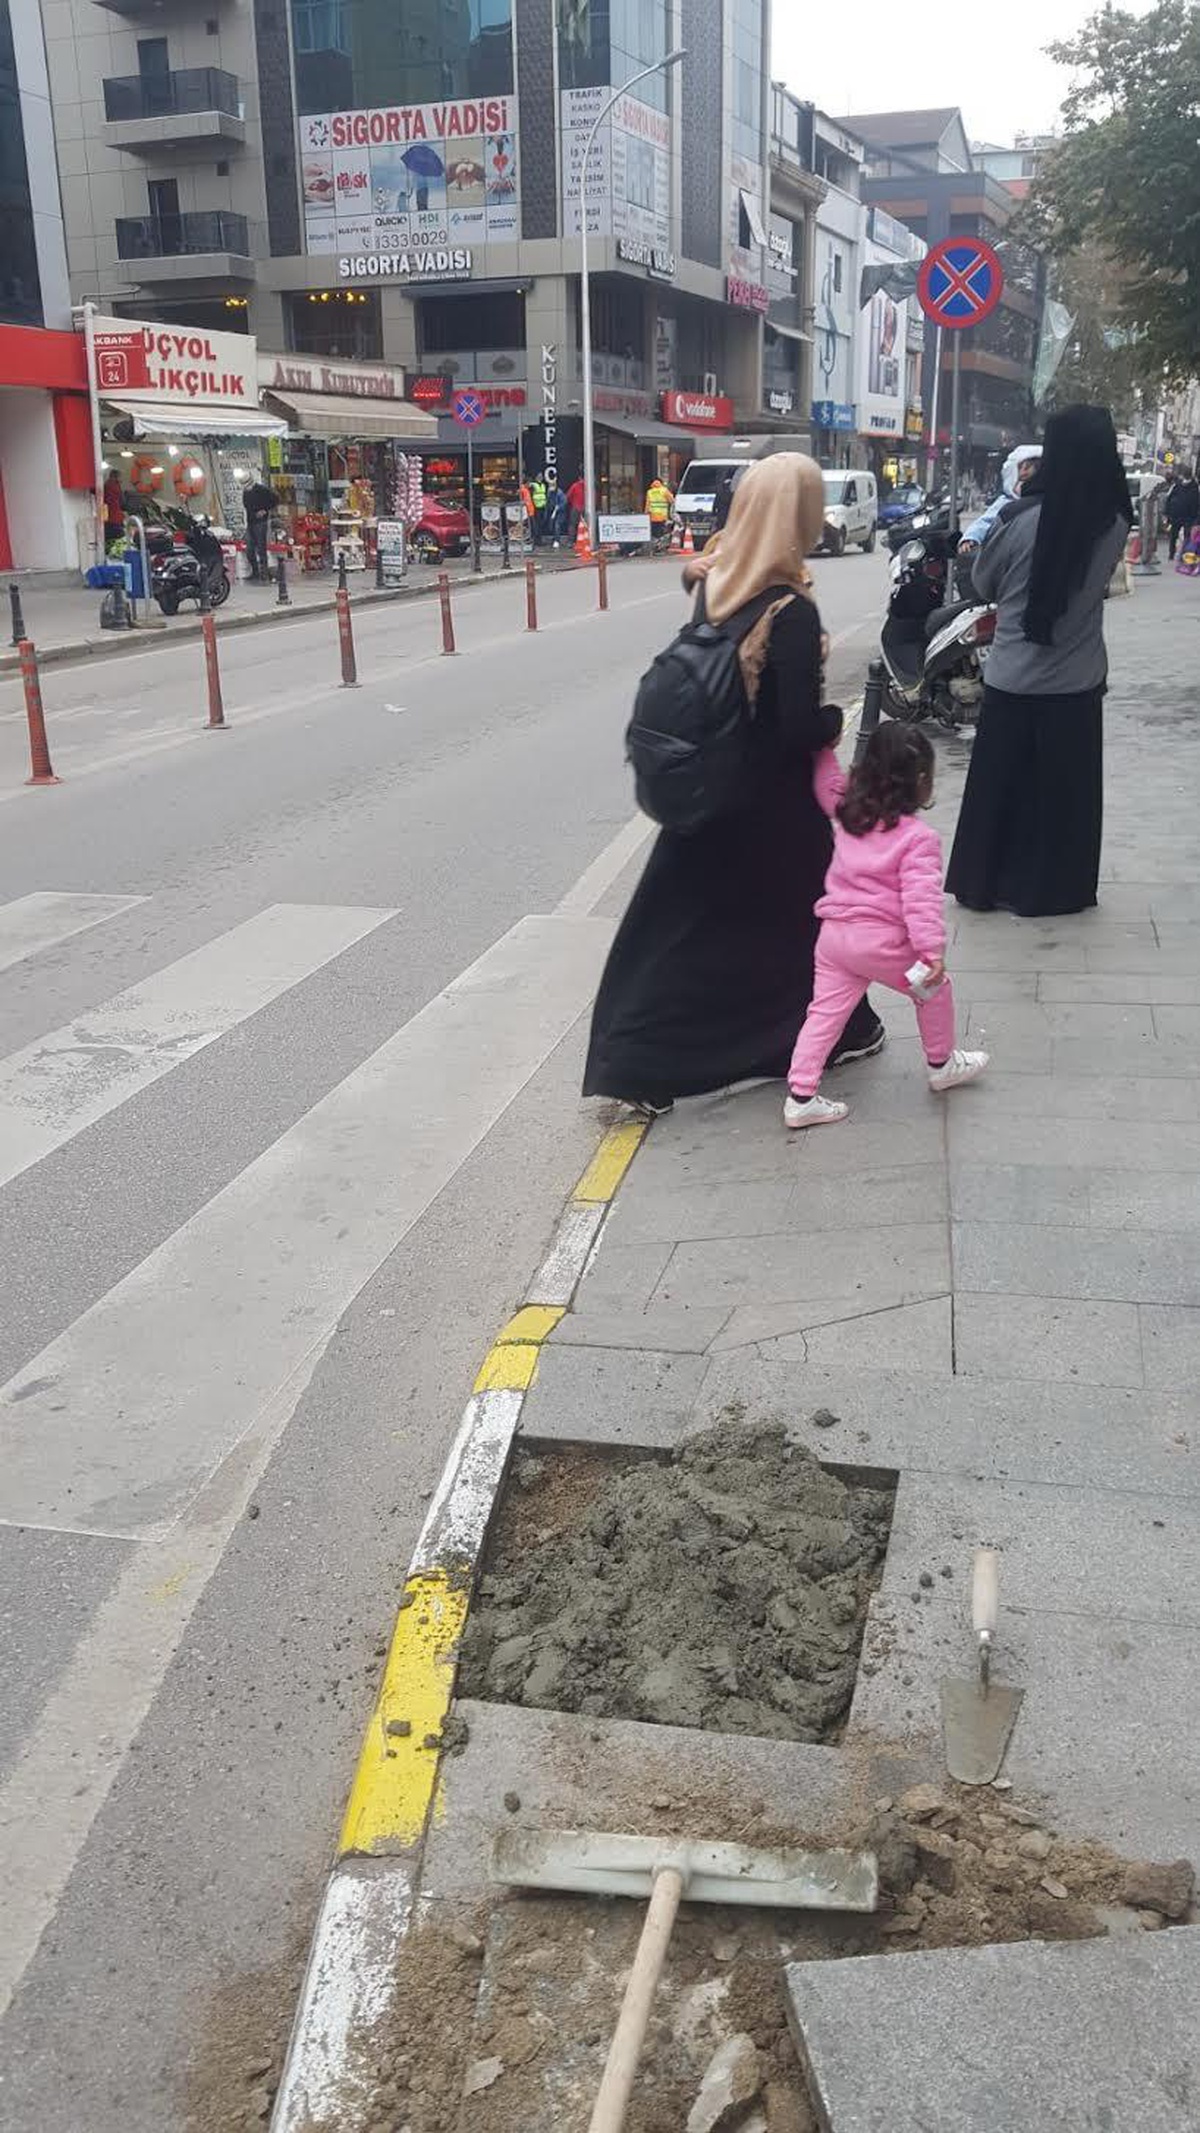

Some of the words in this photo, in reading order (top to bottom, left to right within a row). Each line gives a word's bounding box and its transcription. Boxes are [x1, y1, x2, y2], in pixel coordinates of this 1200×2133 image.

[332, 109, 427, 147] SİGORTA
[433, 101, 508, 139] VADİSİ
[685, 401, 717, 419] vodafone
